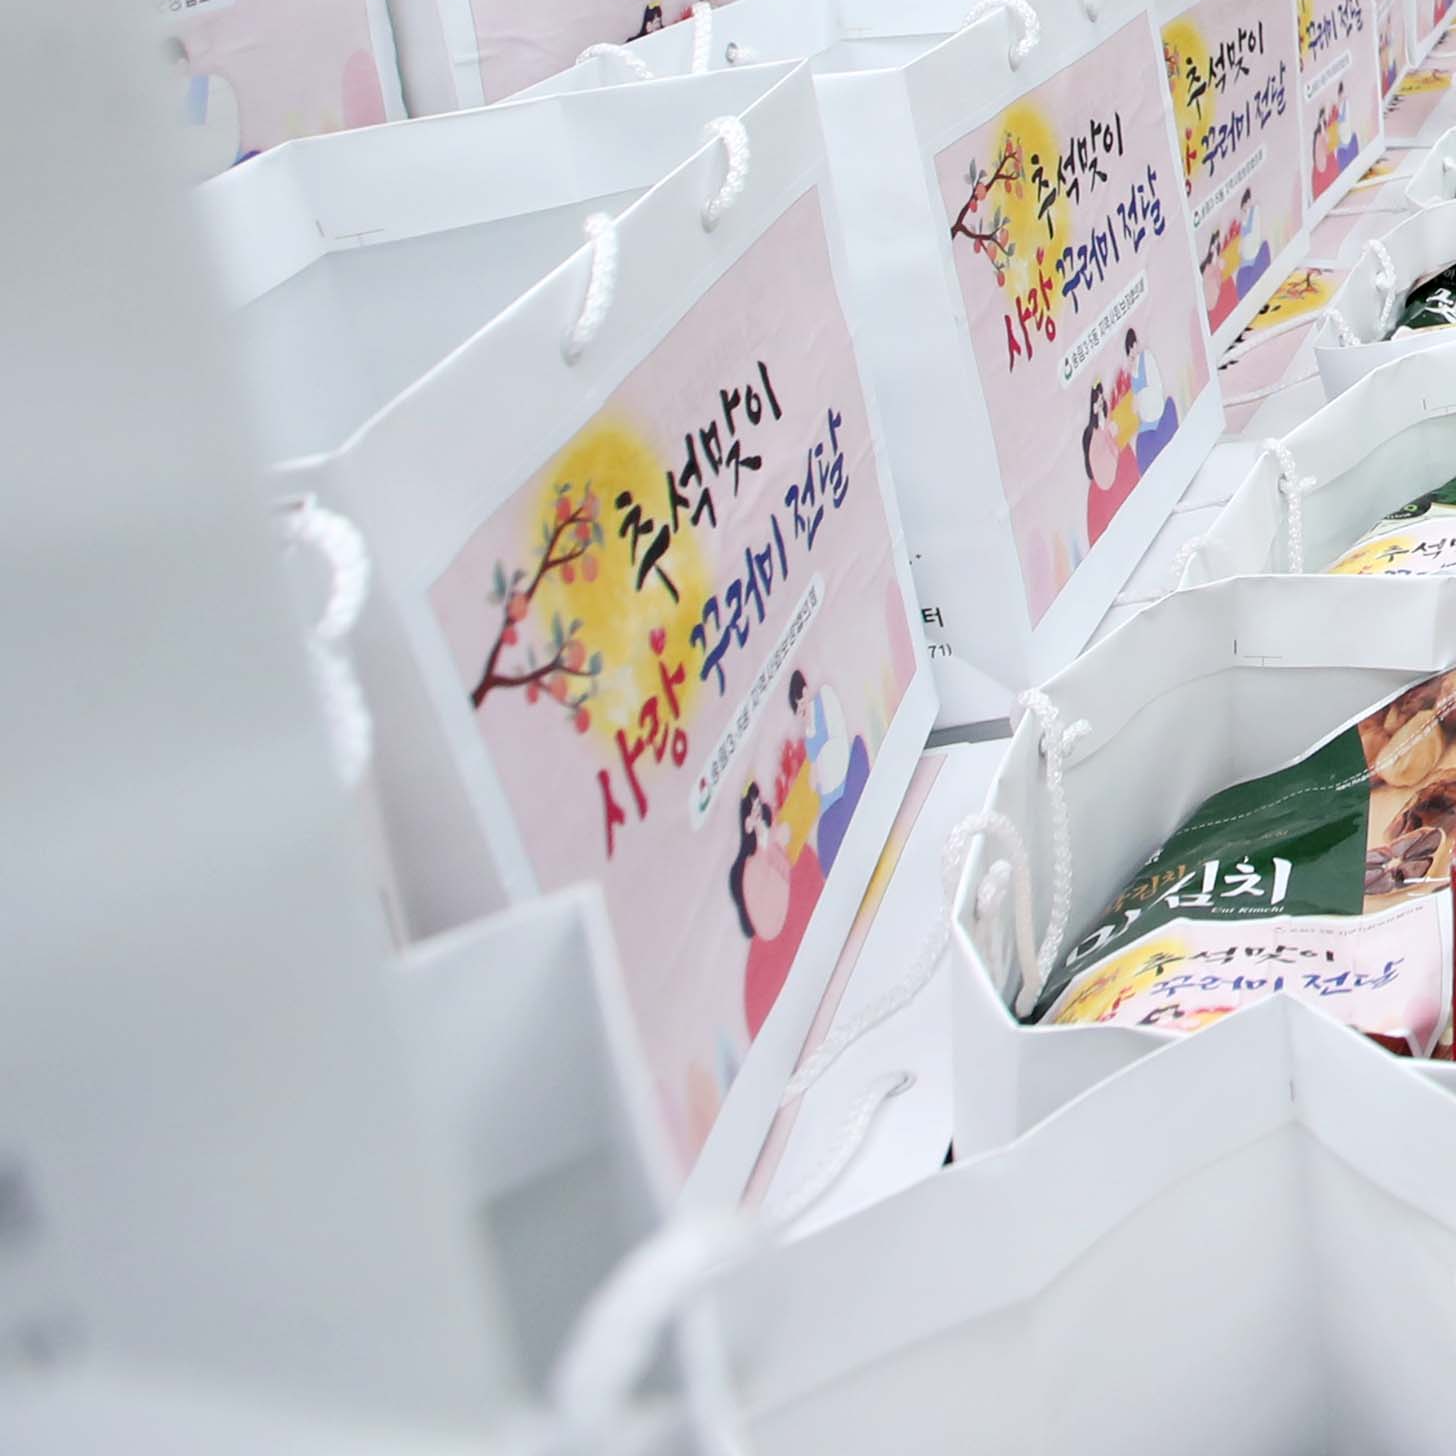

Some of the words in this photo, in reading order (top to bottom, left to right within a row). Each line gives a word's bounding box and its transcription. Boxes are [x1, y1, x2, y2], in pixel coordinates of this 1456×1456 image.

[1185, 20, 1264, 121] 추석맞이
[1030, 111, 1124, 241] 추석맞이
[1004, 268, 1057, 374] 사랑
[1055, 215, 1120, 314] 꾸러미
[1116, 163, 1166, 254] 전달
[613, 360, 783, 605] 추석맞이
[597, 658, 689, 861] 사랑
[689, 513, 789, 697] 꾸러미
[784, 407, 849, 552] 전달
[1135, 944, 1336, 977] 추석맞이
[1150, 974, 1285, 999] 꾸러미
[1302, 957, 1405, 997] 전달
